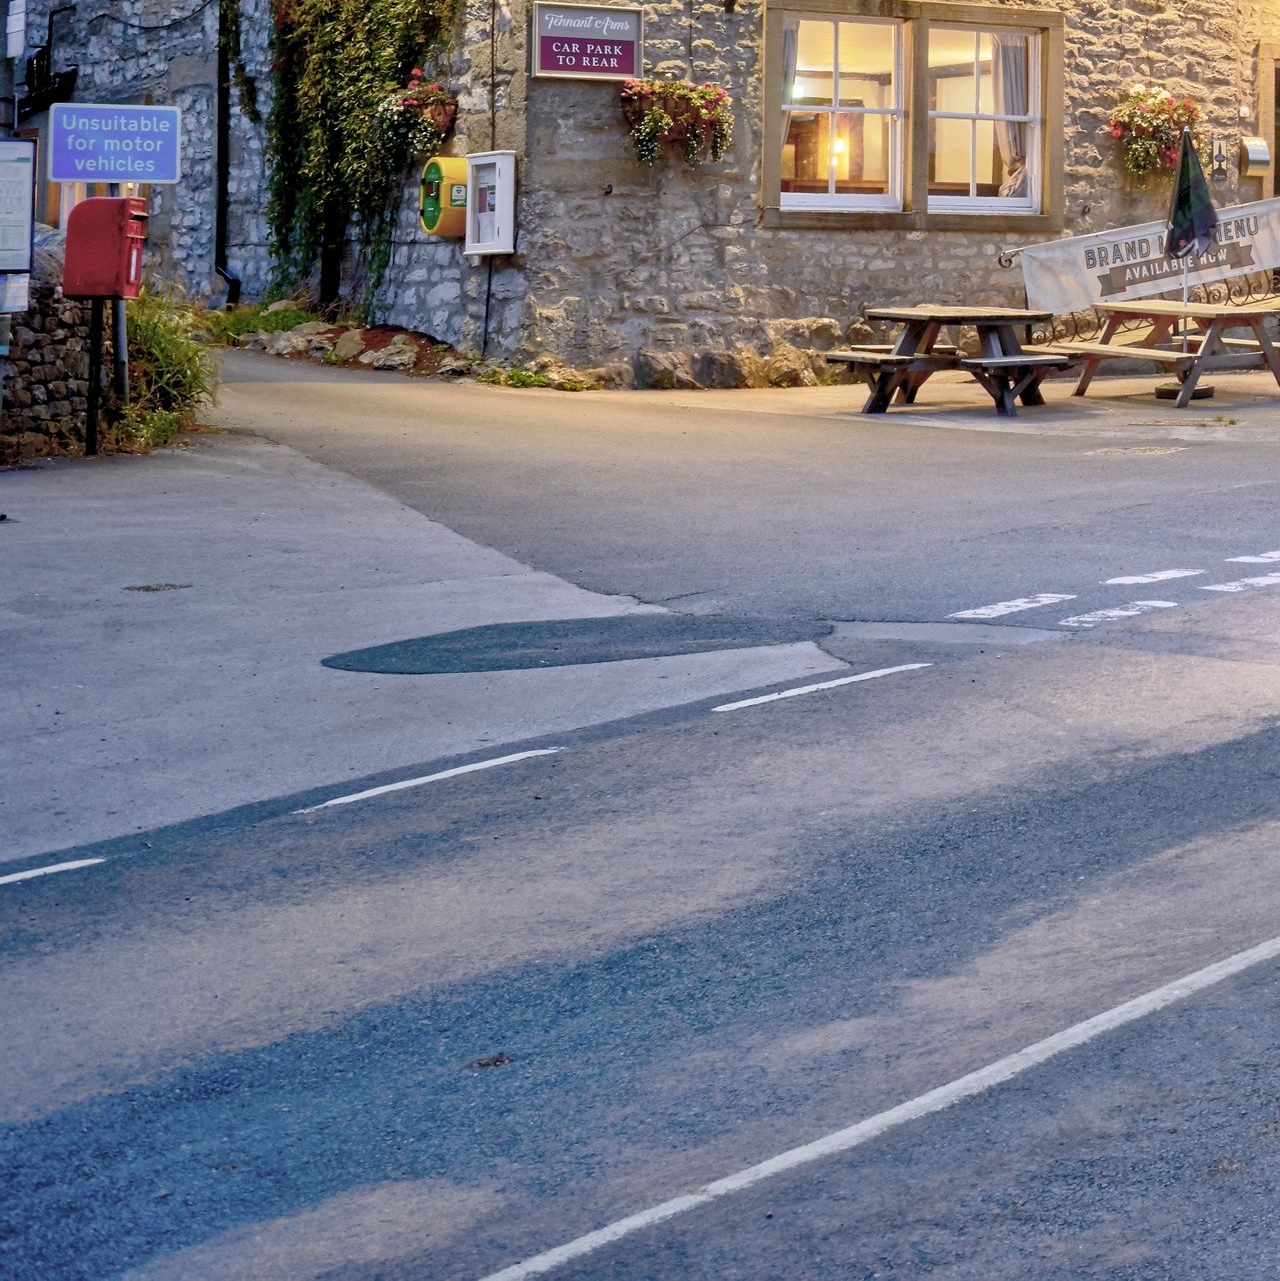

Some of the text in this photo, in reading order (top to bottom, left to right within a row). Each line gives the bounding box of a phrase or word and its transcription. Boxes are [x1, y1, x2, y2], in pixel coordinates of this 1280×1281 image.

[544, 13, 630, 36] Tennant Arms
[552, 42, 623, 55] CAR PARK
[556, 55, 619, 67] TO REAR
[62, 113, 170, 132] Unsuitable
[67, 134, 163, 152] for motor
[74, 155, 155, 172] vehicles
[1084, 238, 1151, 269] BRAND
[1125, 248, 1227, 281] AVAILABLE NOW
